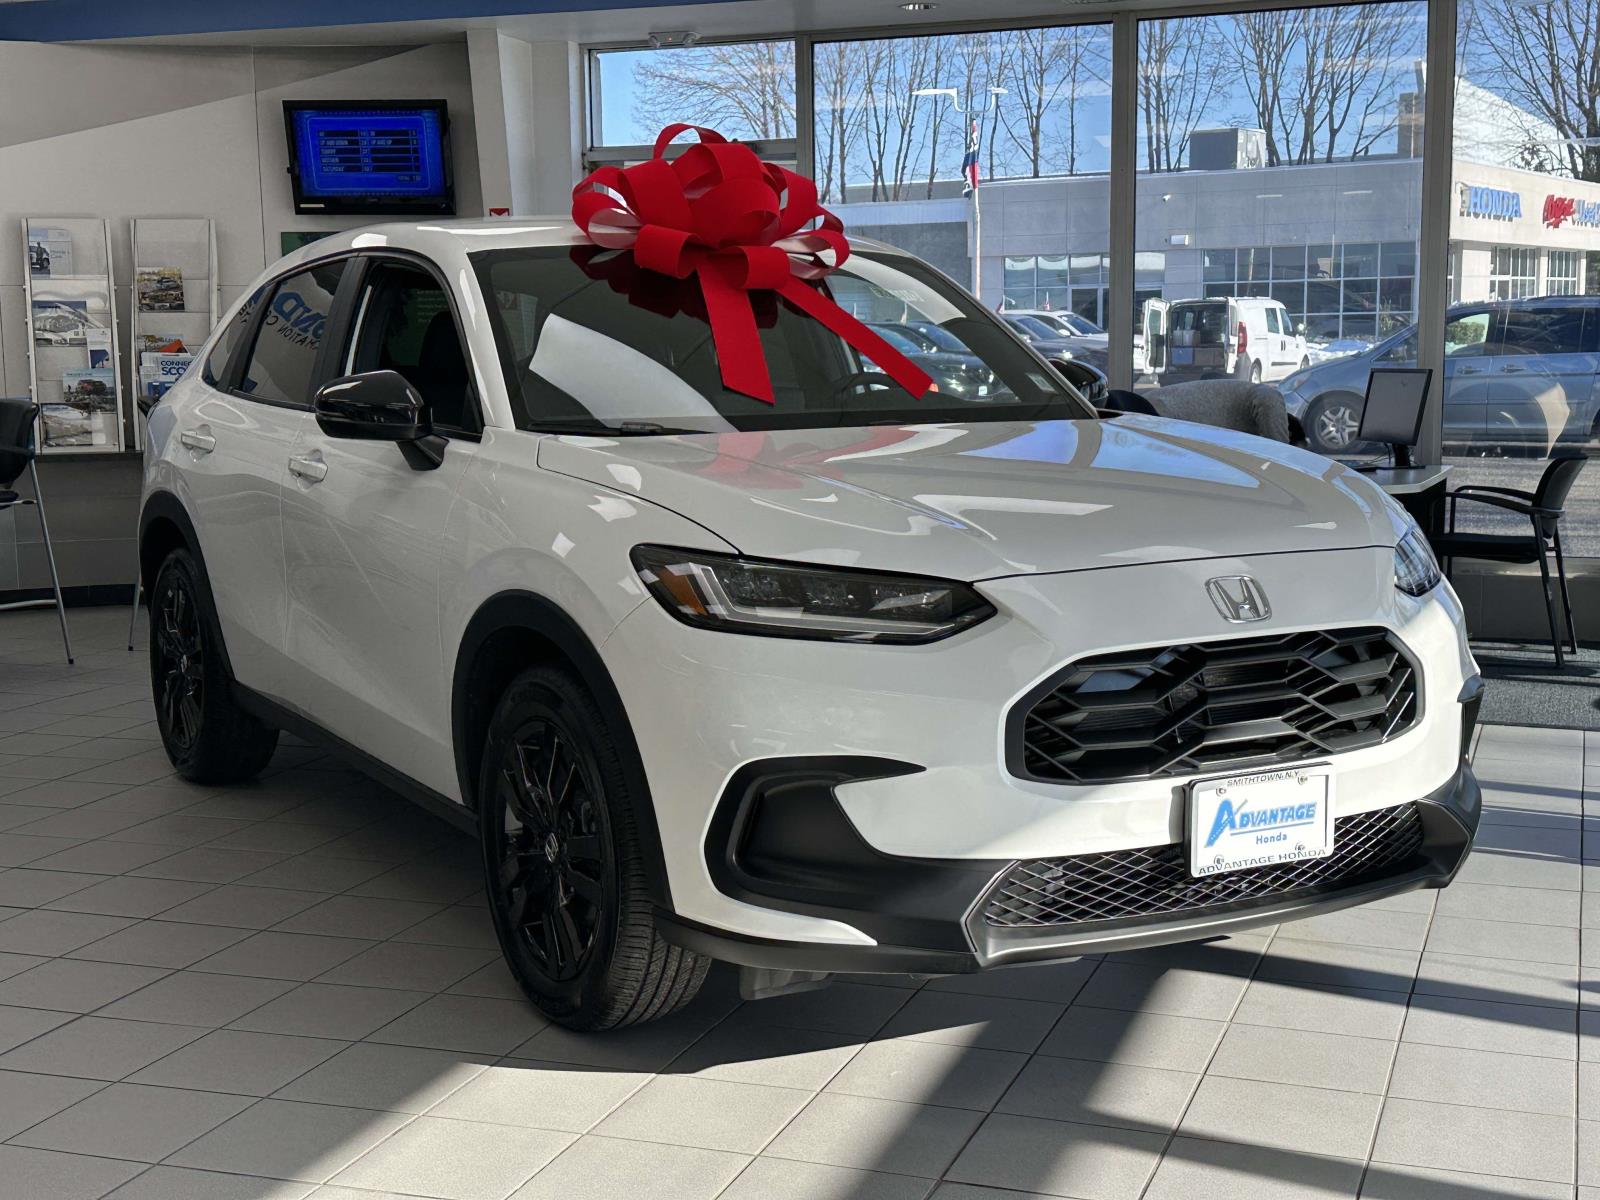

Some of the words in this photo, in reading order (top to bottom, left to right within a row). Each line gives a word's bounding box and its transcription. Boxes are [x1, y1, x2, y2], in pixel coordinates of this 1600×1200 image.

[1468, 186, 1522, 218] HONDA
[1204, 798, 1317, 848] ADVANTAGE
[1255, 831, 1288, 845] Honda
[1198, 855, 1275, 875] ADVANTAGE
[1278, 848, 1326, 861] HONDA
